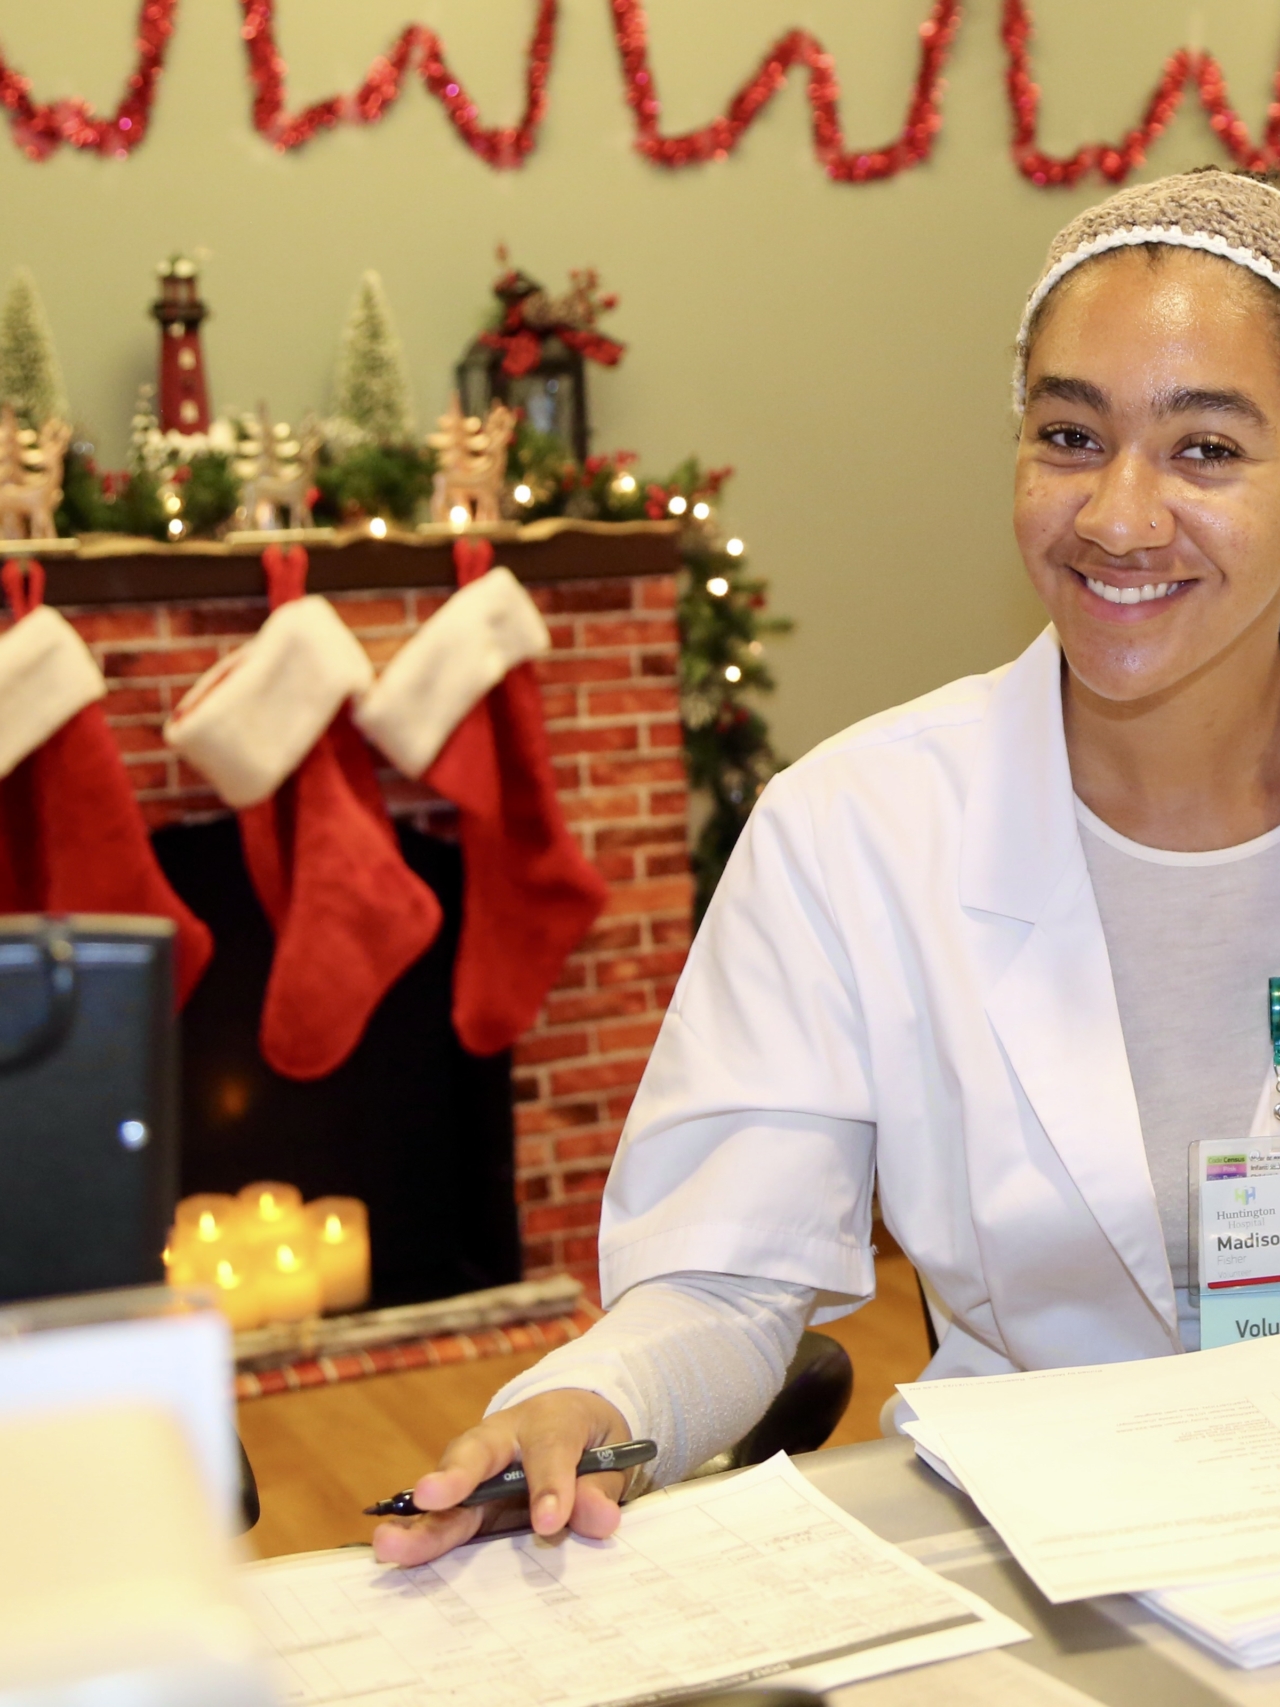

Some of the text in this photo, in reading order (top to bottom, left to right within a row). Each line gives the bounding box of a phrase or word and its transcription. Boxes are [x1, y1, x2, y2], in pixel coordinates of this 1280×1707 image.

[1216, 1207, 1276, 1220] Huntington
[1228, 1217, 1265, 1229] Hospital
[1217, 1254, 1247, 1265] Fisher
